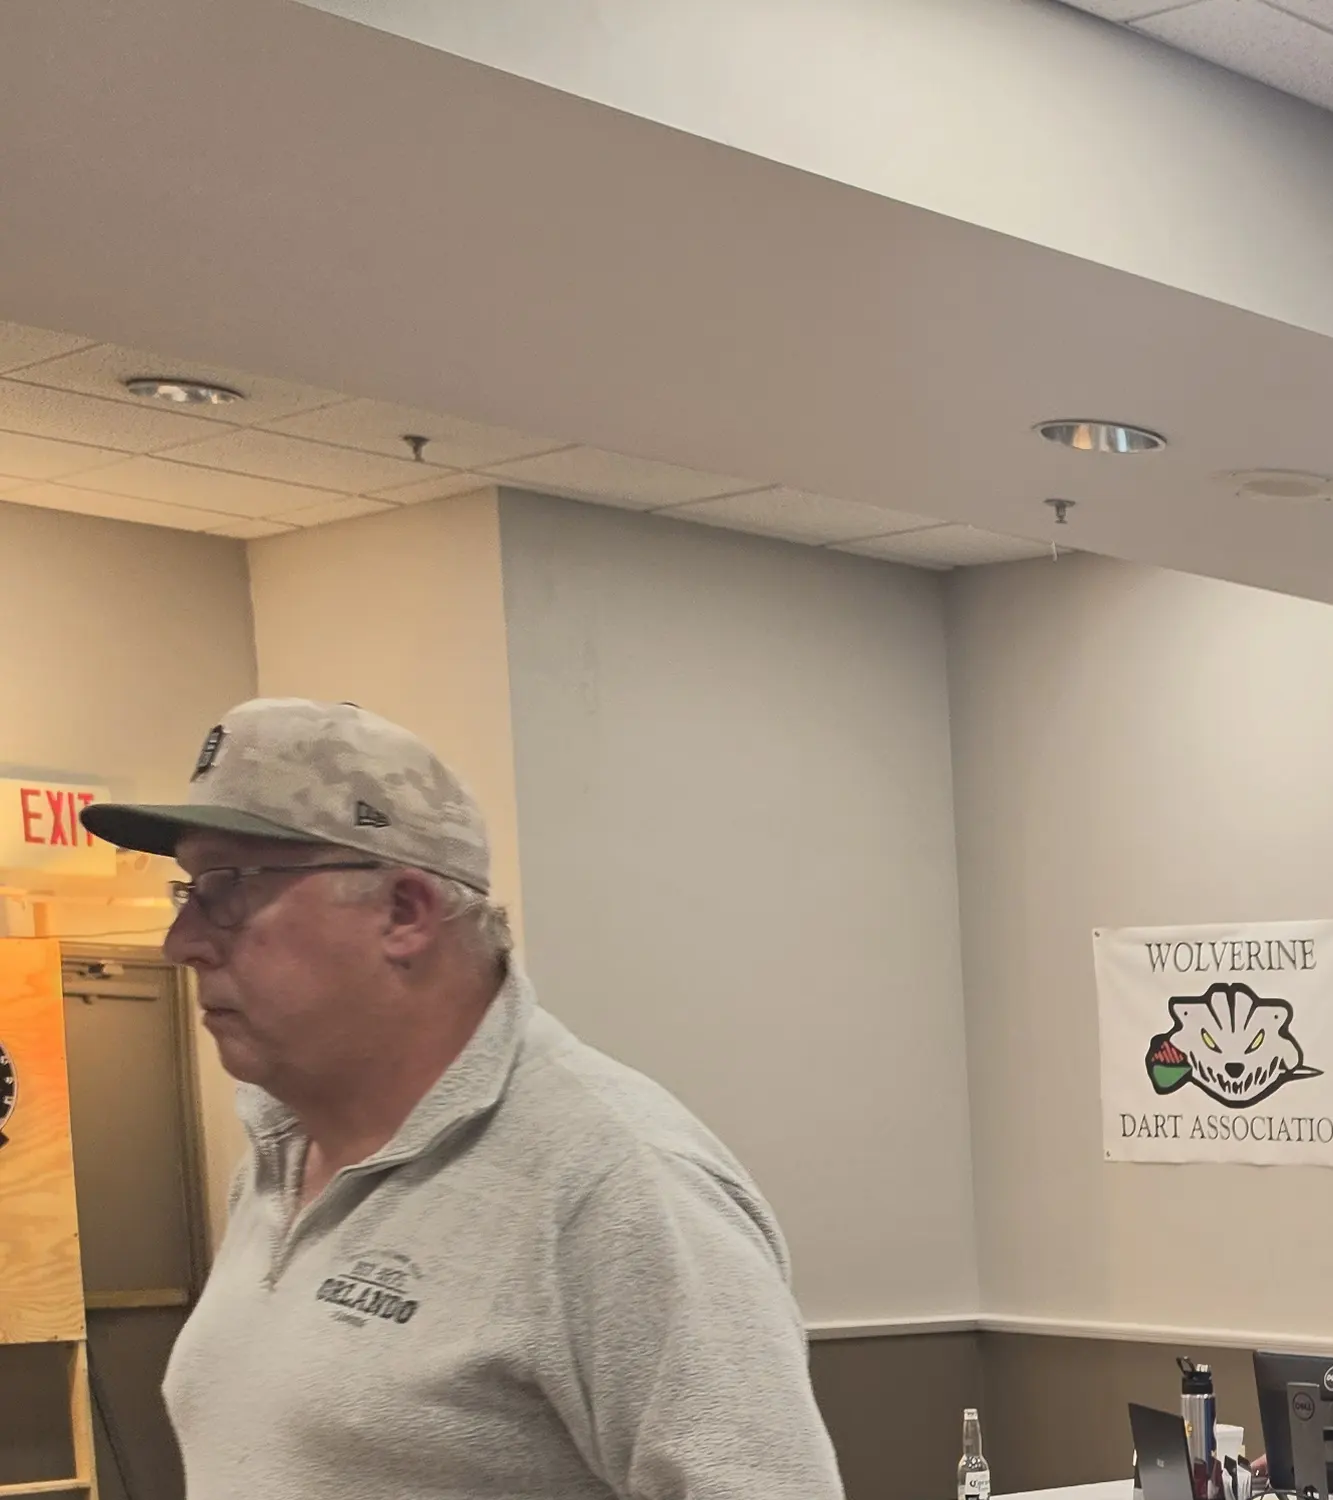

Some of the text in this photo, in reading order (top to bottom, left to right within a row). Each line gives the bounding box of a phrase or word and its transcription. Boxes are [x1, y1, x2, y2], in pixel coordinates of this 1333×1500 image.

[20, 788, 95, 847] EXIT
[1145, 939, 1317, 973] WOLVERINE
[1120, 1113, 1183, 1140] DART
